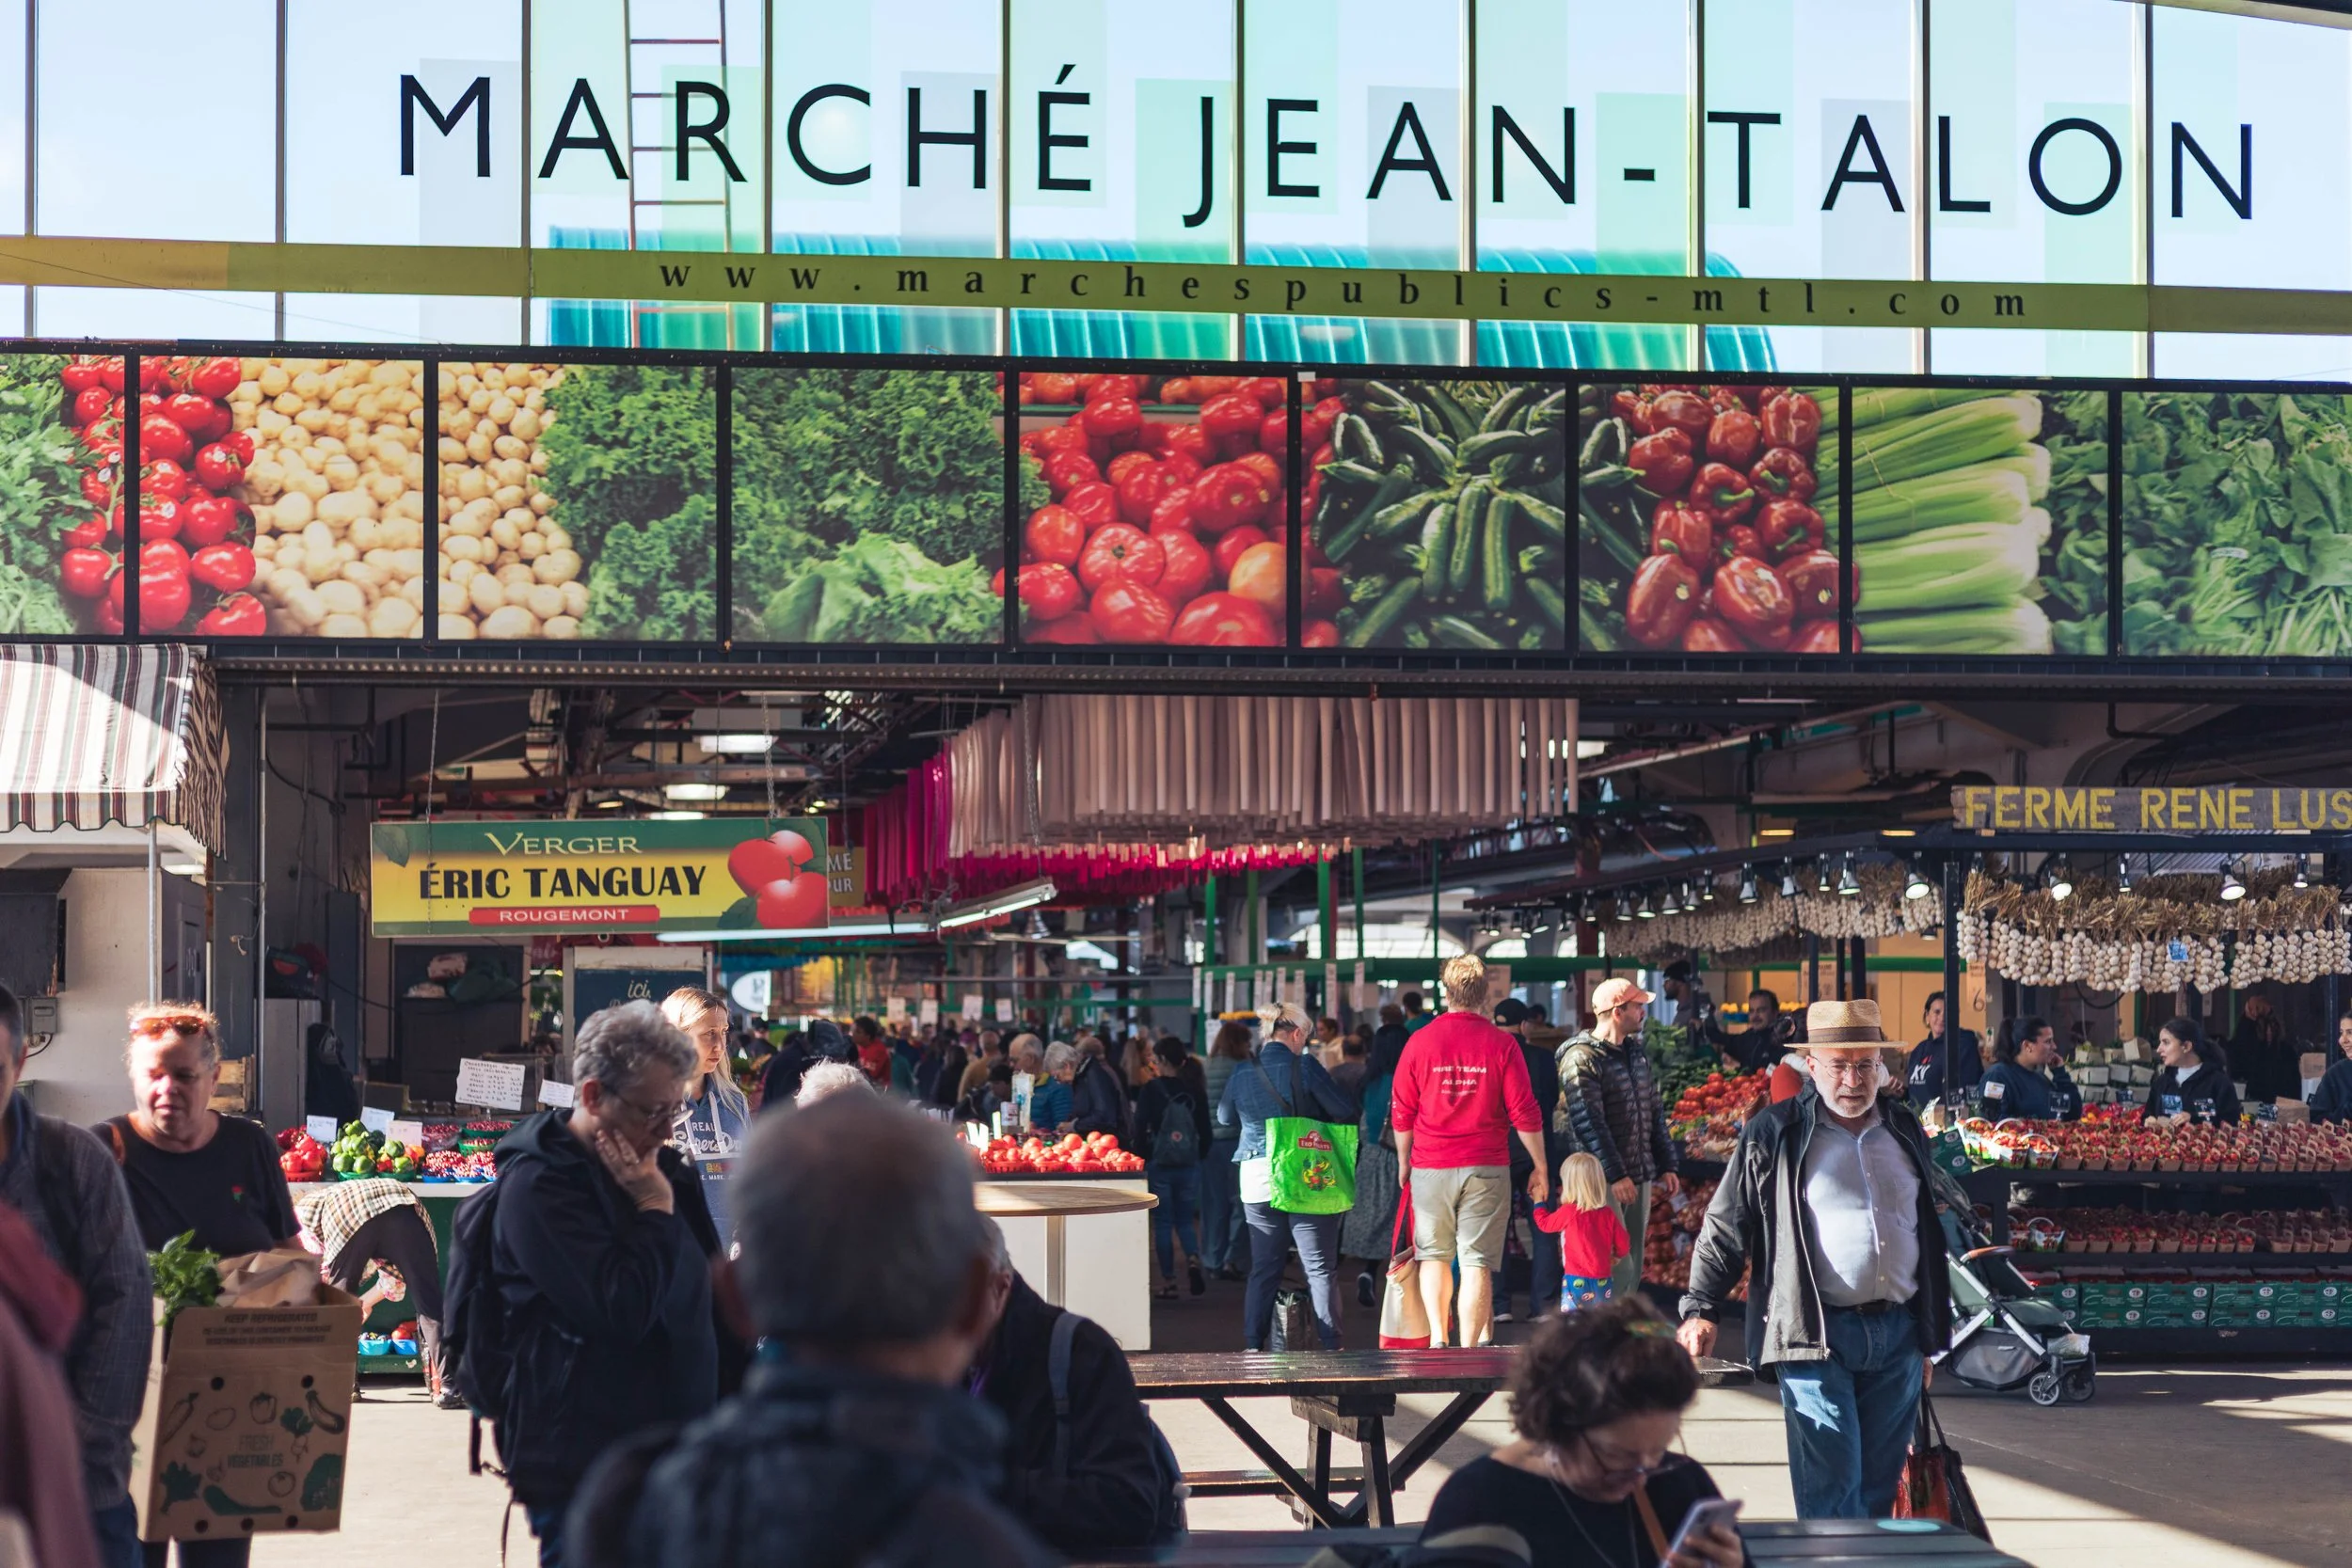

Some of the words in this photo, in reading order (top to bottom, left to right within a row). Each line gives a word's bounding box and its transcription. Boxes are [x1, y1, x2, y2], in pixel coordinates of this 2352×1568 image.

[400, 64, 1091, 192] MARCHÉ
[1183, 96, 2253, 228] JEAN-TALON
[659, 260, 2026, 318] www.marchespublics-mtl.com
[1964, 787, 2116, 830] FERME
[2140, 787, 2254, 830] RENE
[484, 832, 644, 856] VERGER
[420, 862, 511, 899] ÉRIC
[523, 864, 707, 898] TANGUAY
[500, 909, 629, 922] ROUGEMONT
[1456, 1065, 1486, 1073] TEAM
[224, 1313, 248, 1323] KEEP
[249, 1312, 318, 1323] REFRIGERATED
